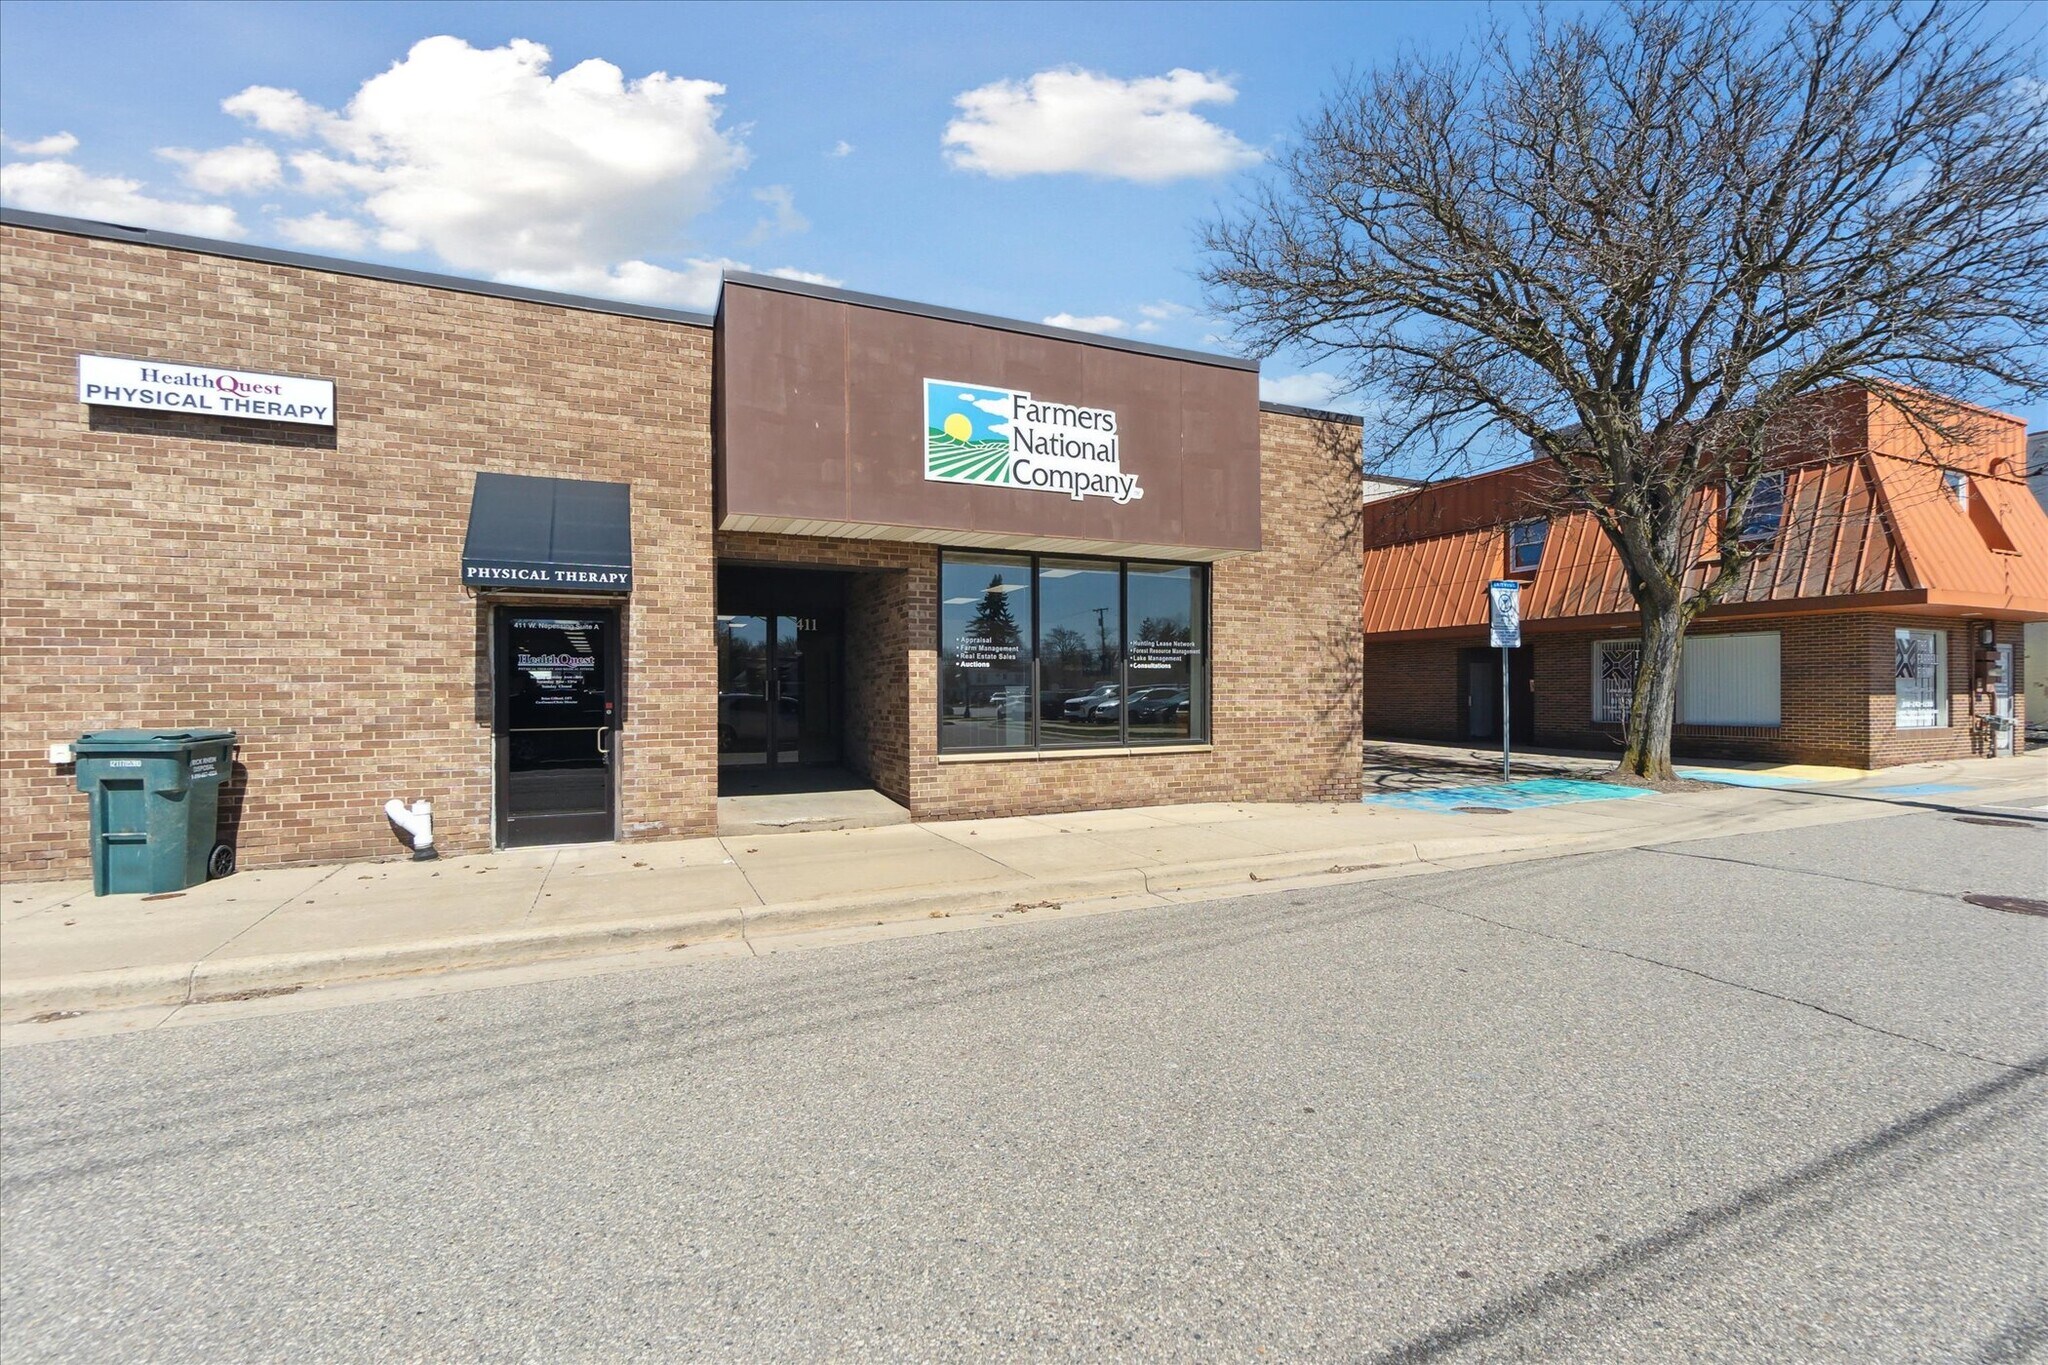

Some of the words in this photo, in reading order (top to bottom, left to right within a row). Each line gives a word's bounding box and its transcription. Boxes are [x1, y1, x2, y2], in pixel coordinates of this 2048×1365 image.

[140, 367, 283, 397] HealthQuest
[86, 383, 213, 410] PHYSICAL
[219, 396, 328, 420] THERAPY
[1013, 394, 1114, 432] Farmers
[1013, 426, 1116, 463] National
[1012, 459, 1134, 500] Company
[467, 567, 550, 581] PHYSICAL
[555, 570, 628, 584] THERAPY
[796, 618, 817, 631] 411
[517, 653, 596, 668] HealthQuest
